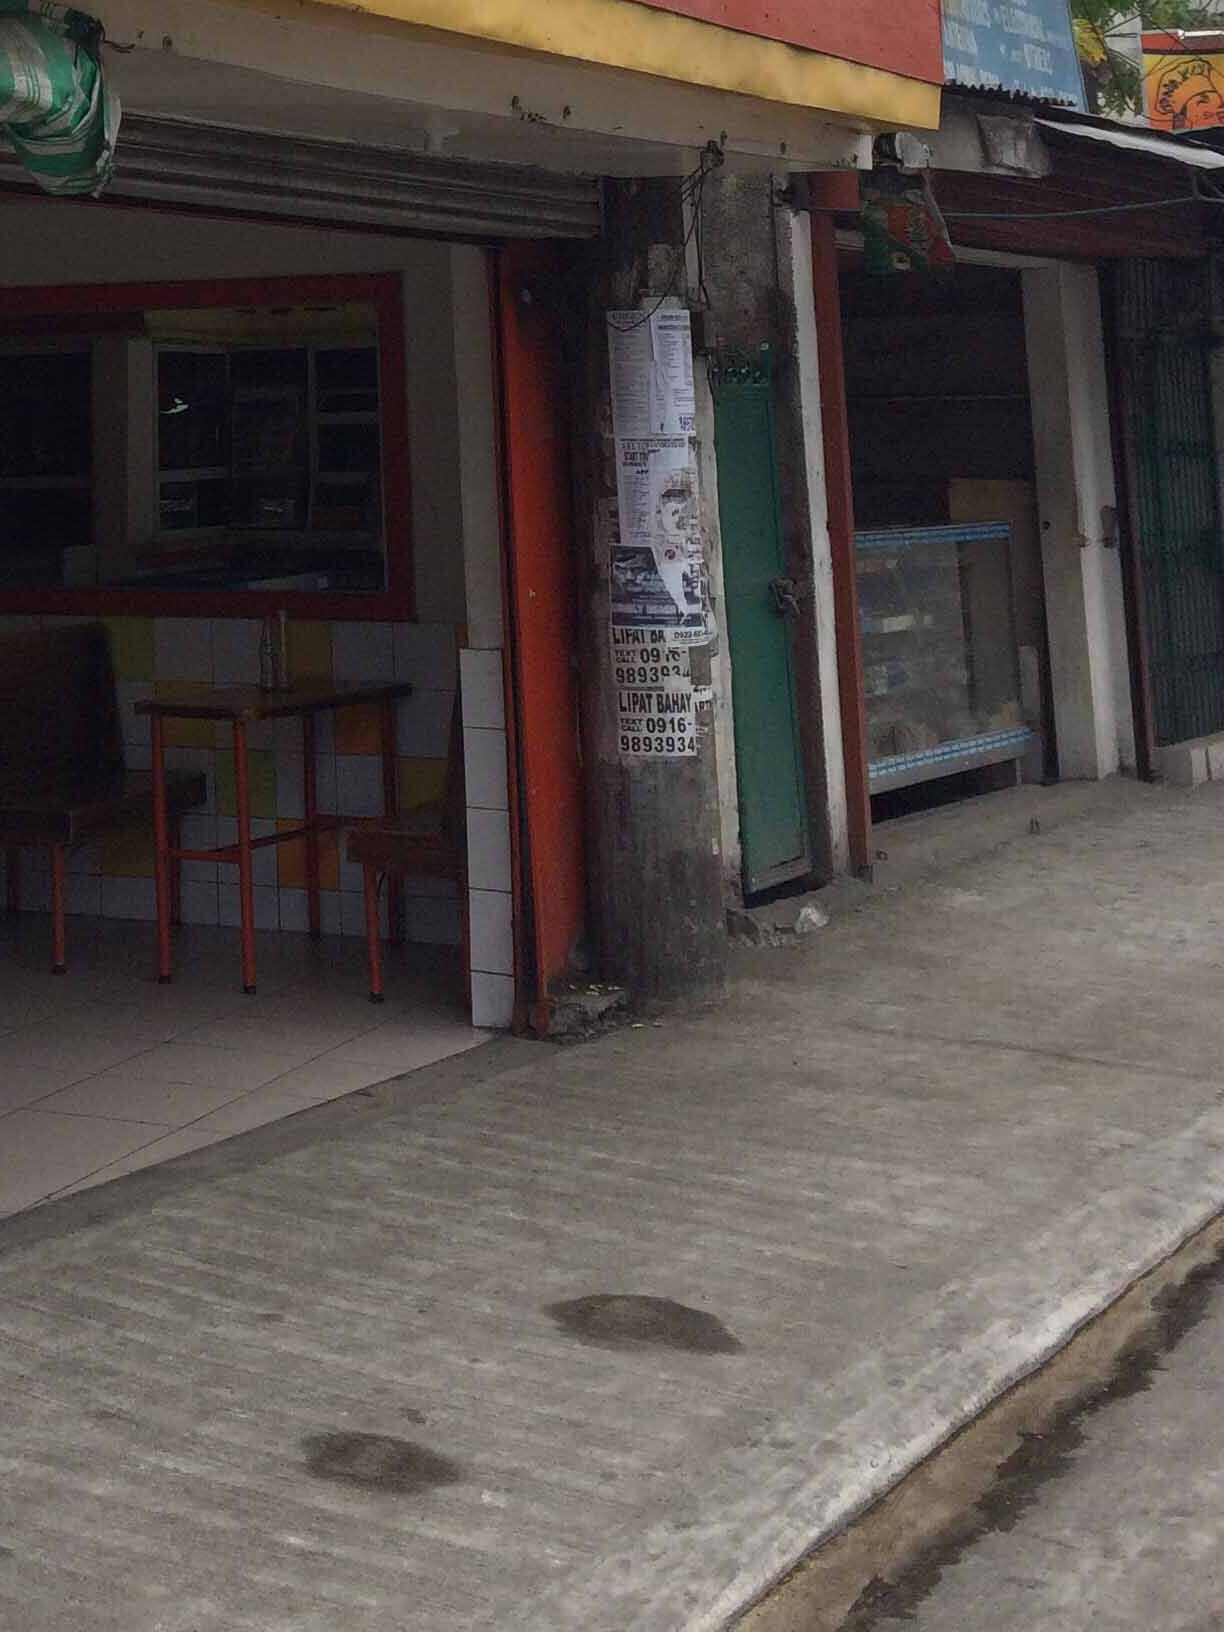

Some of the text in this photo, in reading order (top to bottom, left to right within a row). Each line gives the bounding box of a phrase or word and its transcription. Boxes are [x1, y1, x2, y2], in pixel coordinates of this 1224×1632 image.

[618, 692, 652, 713] LIPAT
[656, 693, 692, 713] BAHAY
[646, 717, 693, 733] 0916-
[620, 735, 695, 752] 9893934
